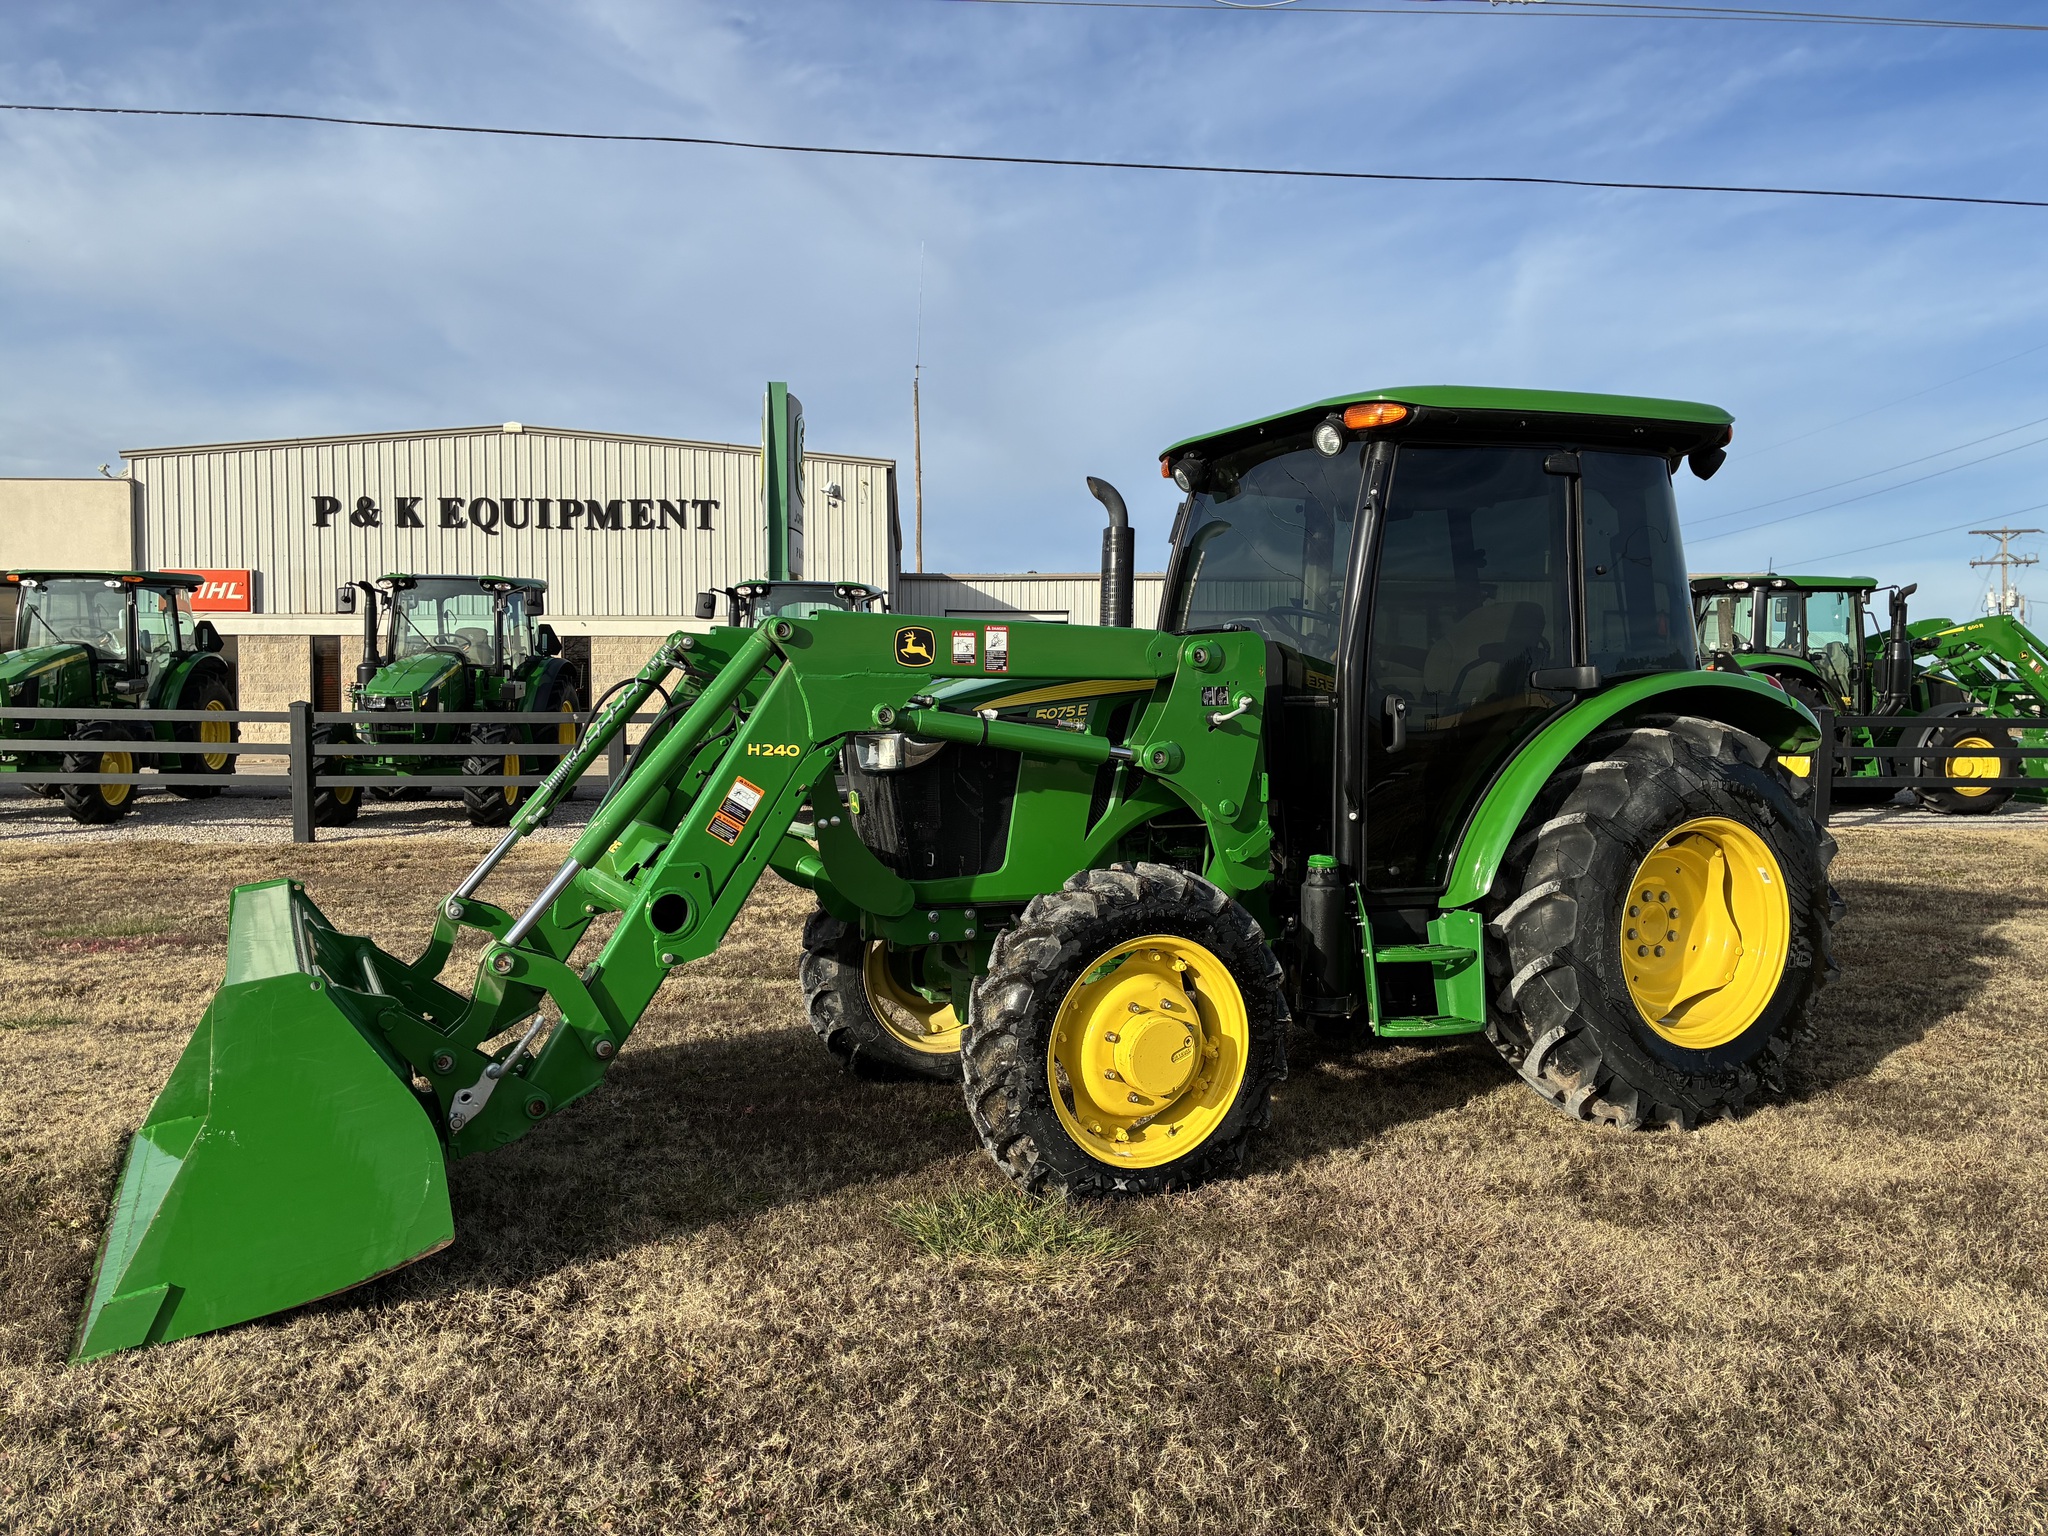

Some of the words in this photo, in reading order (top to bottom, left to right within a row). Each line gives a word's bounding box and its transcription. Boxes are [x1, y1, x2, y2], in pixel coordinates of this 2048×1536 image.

[311, 496, 342, 527] P
[350, 496, 382, 528] &
[395, 497, 424, 528] K
[437, 497, 720, 535] EQUIPMENT
[188, 582, 244, 600] IHL
[747, 743, 800, 757] H240
